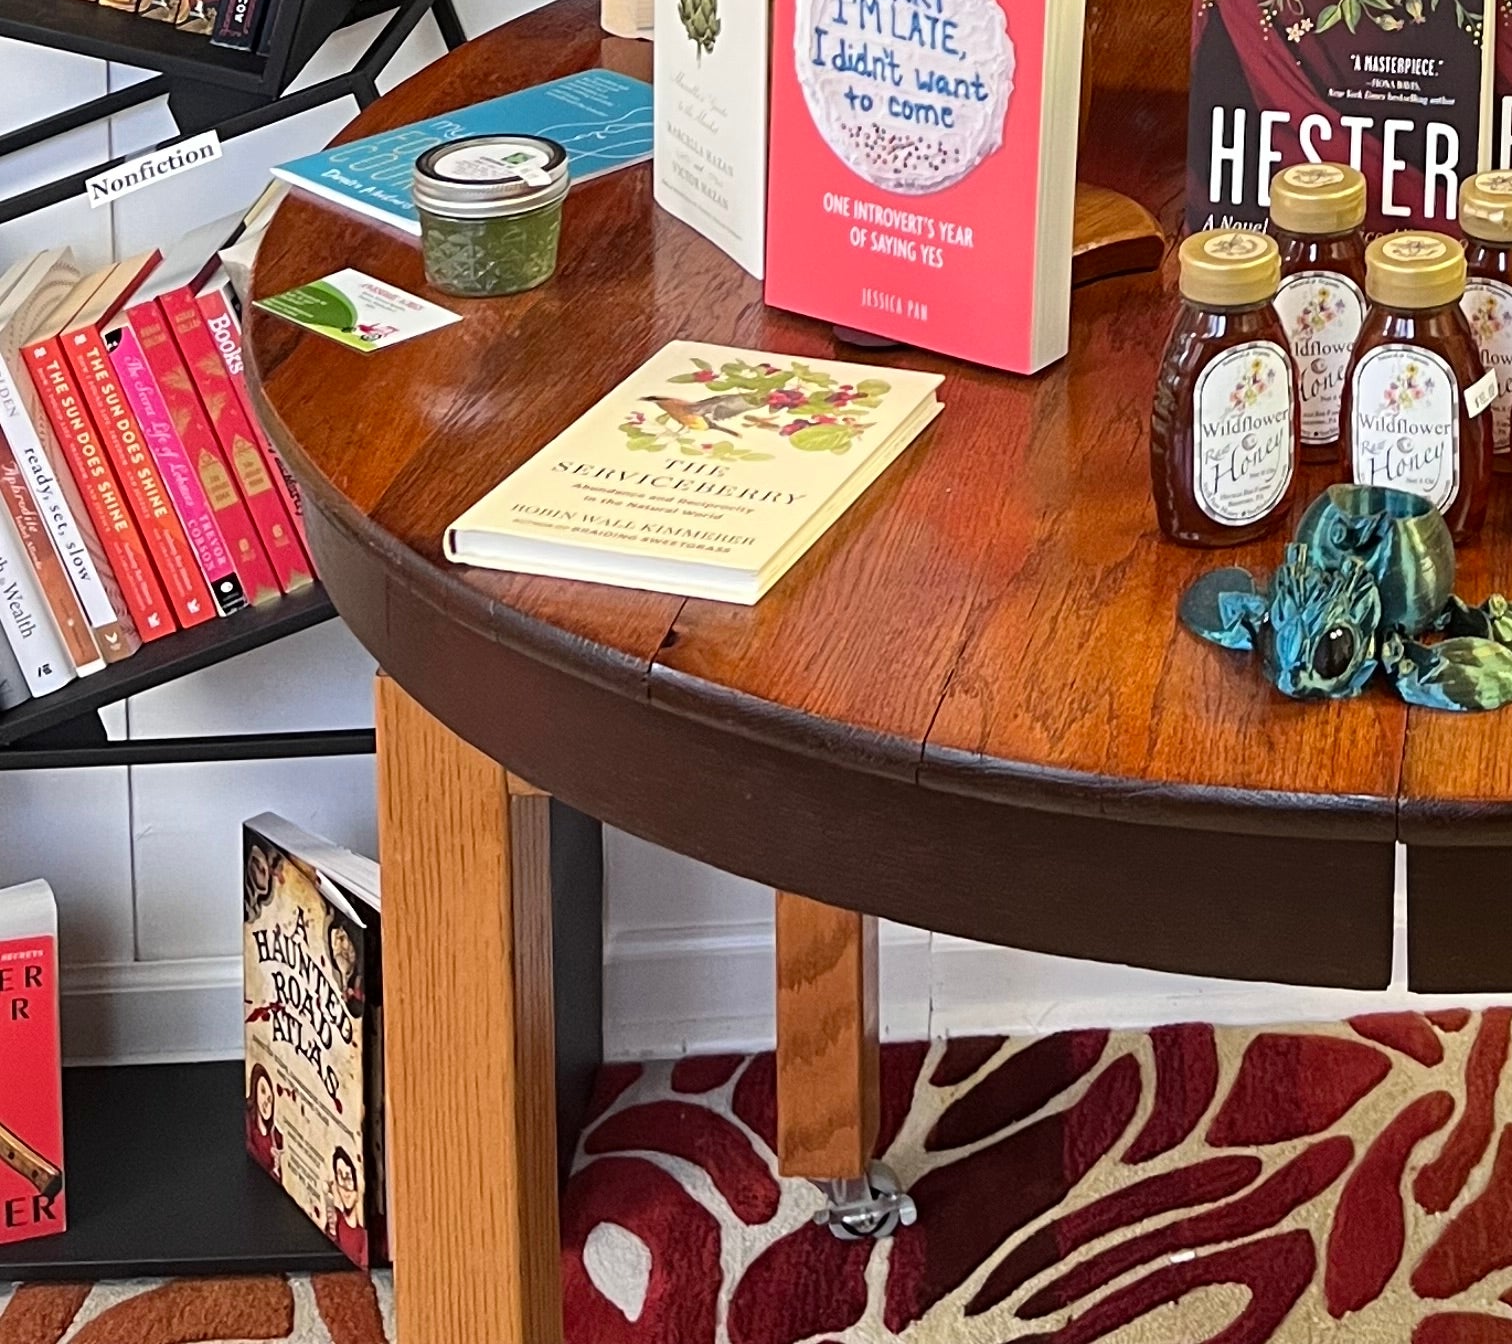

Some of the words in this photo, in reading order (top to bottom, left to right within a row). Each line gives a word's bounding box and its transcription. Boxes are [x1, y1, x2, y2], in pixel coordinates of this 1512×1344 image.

[891, 2, 966, 61] LATE,
[812, 26, 828, 66] I
[831, 39, 903, 86] didn't
[915, 69, 989, 102] want
[844, 86, 873, 111] to
[889, 95, 955, 128] come
[91, 141, 216, 202] Nonfiction
[823, 192, 850, 216] ONE
[853, 200, 935, 239] INTROVERT'S
[939, 221, 973, 247] YEAR
[850, 226, 867, 247] OF
[871, 232, 916, 261] SAYING
[920, 245, 943, 268] YES
[862, 288, 902, 313] JESSICA
[908, 300, 927, 320] PAN
[208, 313, 243, 375] Books
[46, 361, 68, 386] THE
[62, 395, 84, 430] SUN
[76, 432, 104, 477] DOES
[98, 481, 128, 533] SHINE
[1203, 408, 1288, 438] Wildflower
[1360, 413, 1450, 436] Wildflower
[552, 462, 806, 505] SERVICEBERRY
[664, 458, 730, 477] THE
[1212, 428, 1284, 495] Honey
[1369, 441, 1445, 493] Honey
[24, 447, 50, 500] ready,
[50, 504, 66, 536] set,
[66, 541, 92, 581] slow
[511, 504, 576, 520] ROBIN
[582, 514, 635, 530] WALL
[641, 523, 756, 546] KIMMERER
[4, 583, 37, 639] Wealth
[293, 906, 309, 944] A
[253, 923, 353, 1045] HAUNTED
[271, 972, 333, 1050] ROAD
[272, 1010, 340, 1099] ATLAS
